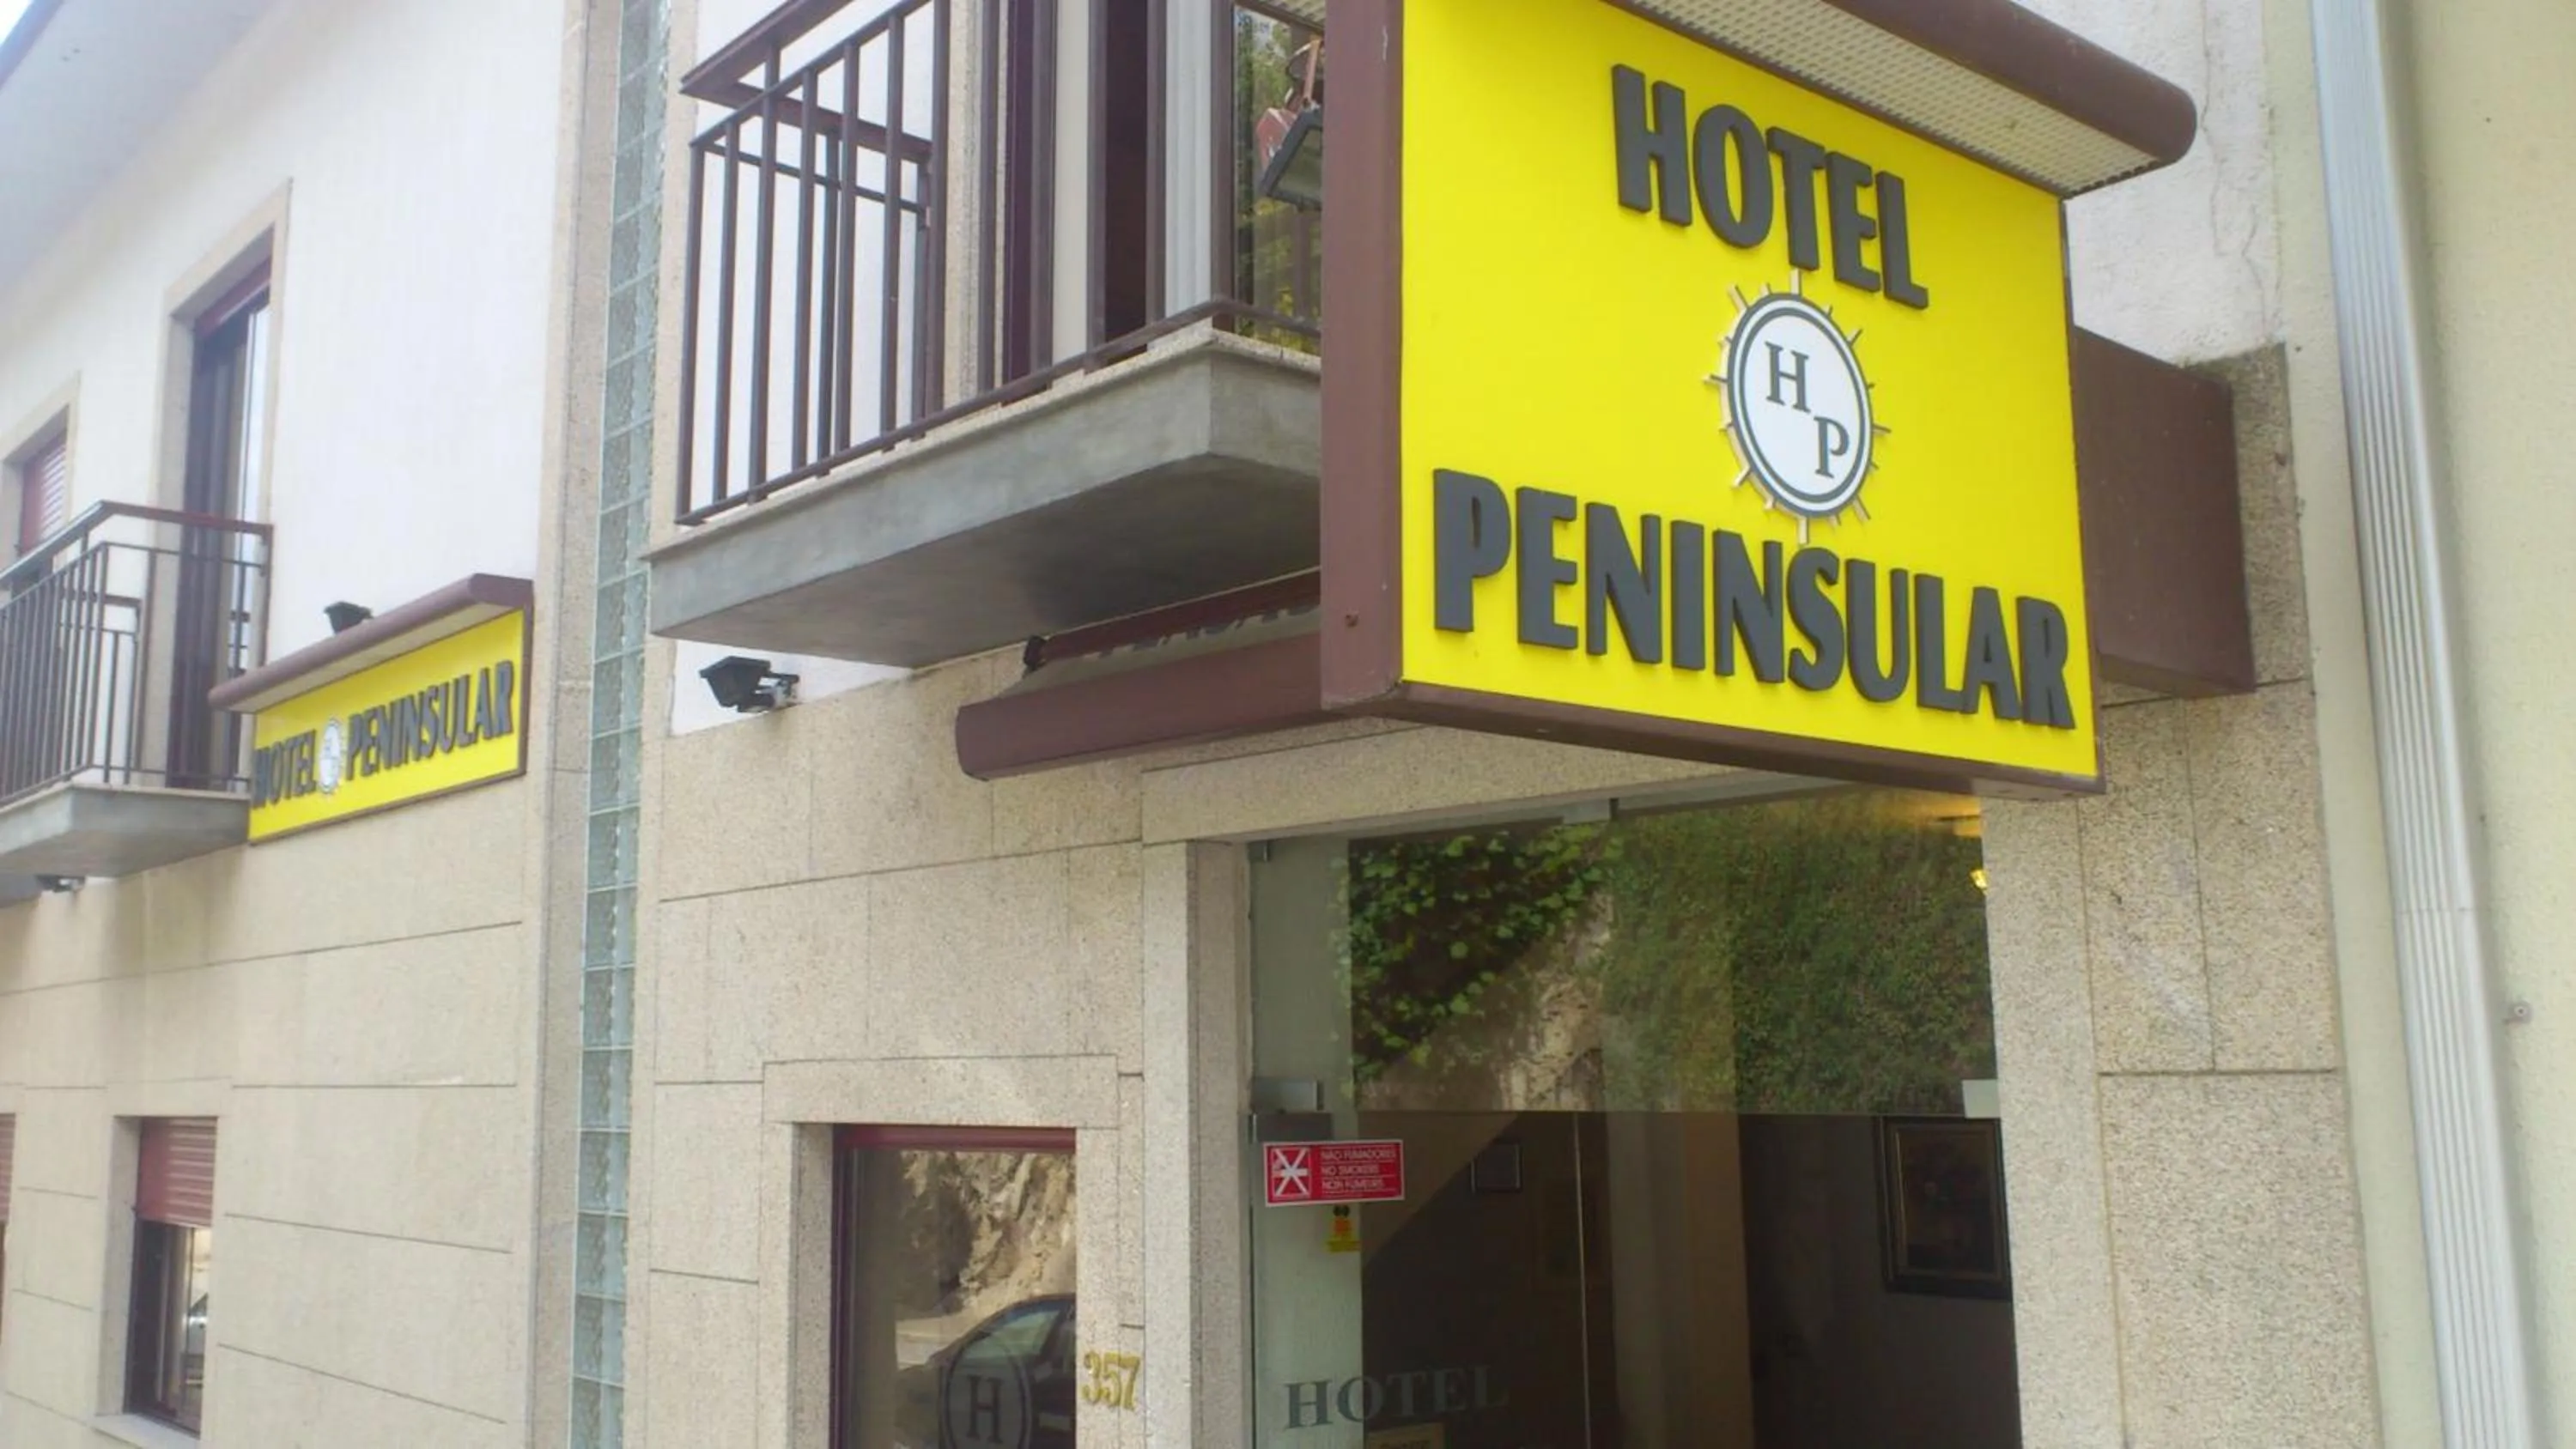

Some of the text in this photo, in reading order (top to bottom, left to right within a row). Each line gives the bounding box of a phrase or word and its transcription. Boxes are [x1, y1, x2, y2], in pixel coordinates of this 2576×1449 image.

[1611, 64, 1929, 309] HOTEL
[1432, 468, 2075, 730] PENINSULAR
[252, 729, 317, 809] HOTEL
[345, 659, 514, 781] PENINSULAR
[1321, 1164, 1336, 1175] NO
[1321, 1179, 1343, 1190] NON
[967, 1374, 1003, 1443] H
[1082, 1349, 1140, 1410] 357
[1284, 1364, 1509, 1429] HOTEL
